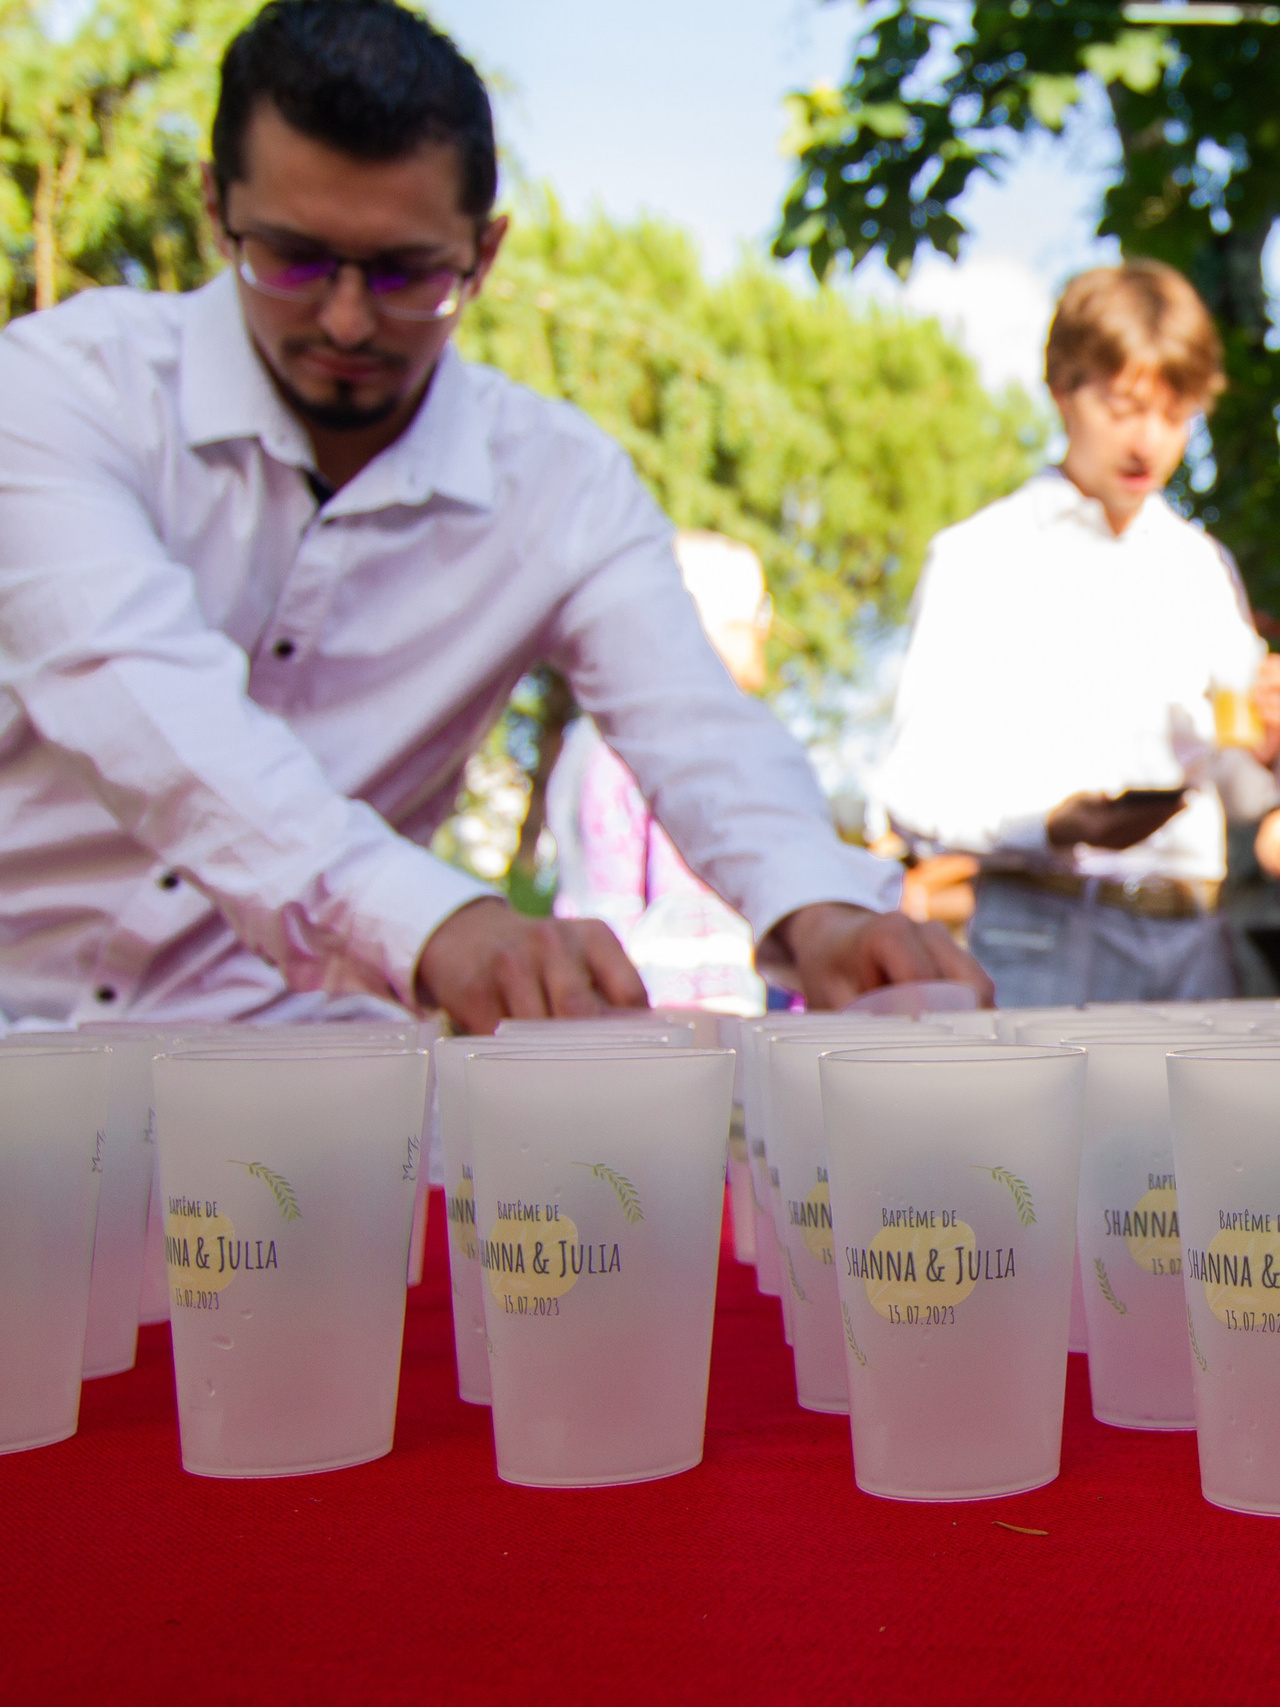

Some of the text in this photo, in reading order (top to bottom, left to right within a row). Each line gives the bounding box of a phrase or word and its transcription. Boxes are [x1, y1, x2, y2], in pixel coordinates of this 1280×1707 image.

[1148, 1173, 1177, 1190] BAPT
[206, 1201, 218, 1218] DE
[497, 1200, 560, 1222] BAPTÊME DE
[788, 1200, 833, 1229] SHANN
[881, 1206, 957, 1229] BAPTÊME DE
[1219, 1209, 1271, 1233] BAPTÊME
[1104, 1209, 1180, 1238] SHANNA
[196, 1236, 210, 1269] &
[217, 1236, 278, 1273] JULIA
[532, 1241, 550, 1275] &
[558, 1240, 621, 1278] JULIA
[845, 1246, 917, 1282] SHANNA
[926, 1248, 946, 1283] &
[955, 1245, 1016, 1285] JULIA
[1187, 1247, 1253, 1288] SHANNA
[1261, 1253, 1280, 1289] &
[503, 1294, 560, 1316] 15.07.2023
[889, 1304, 955, 1325] 15.07.2023
